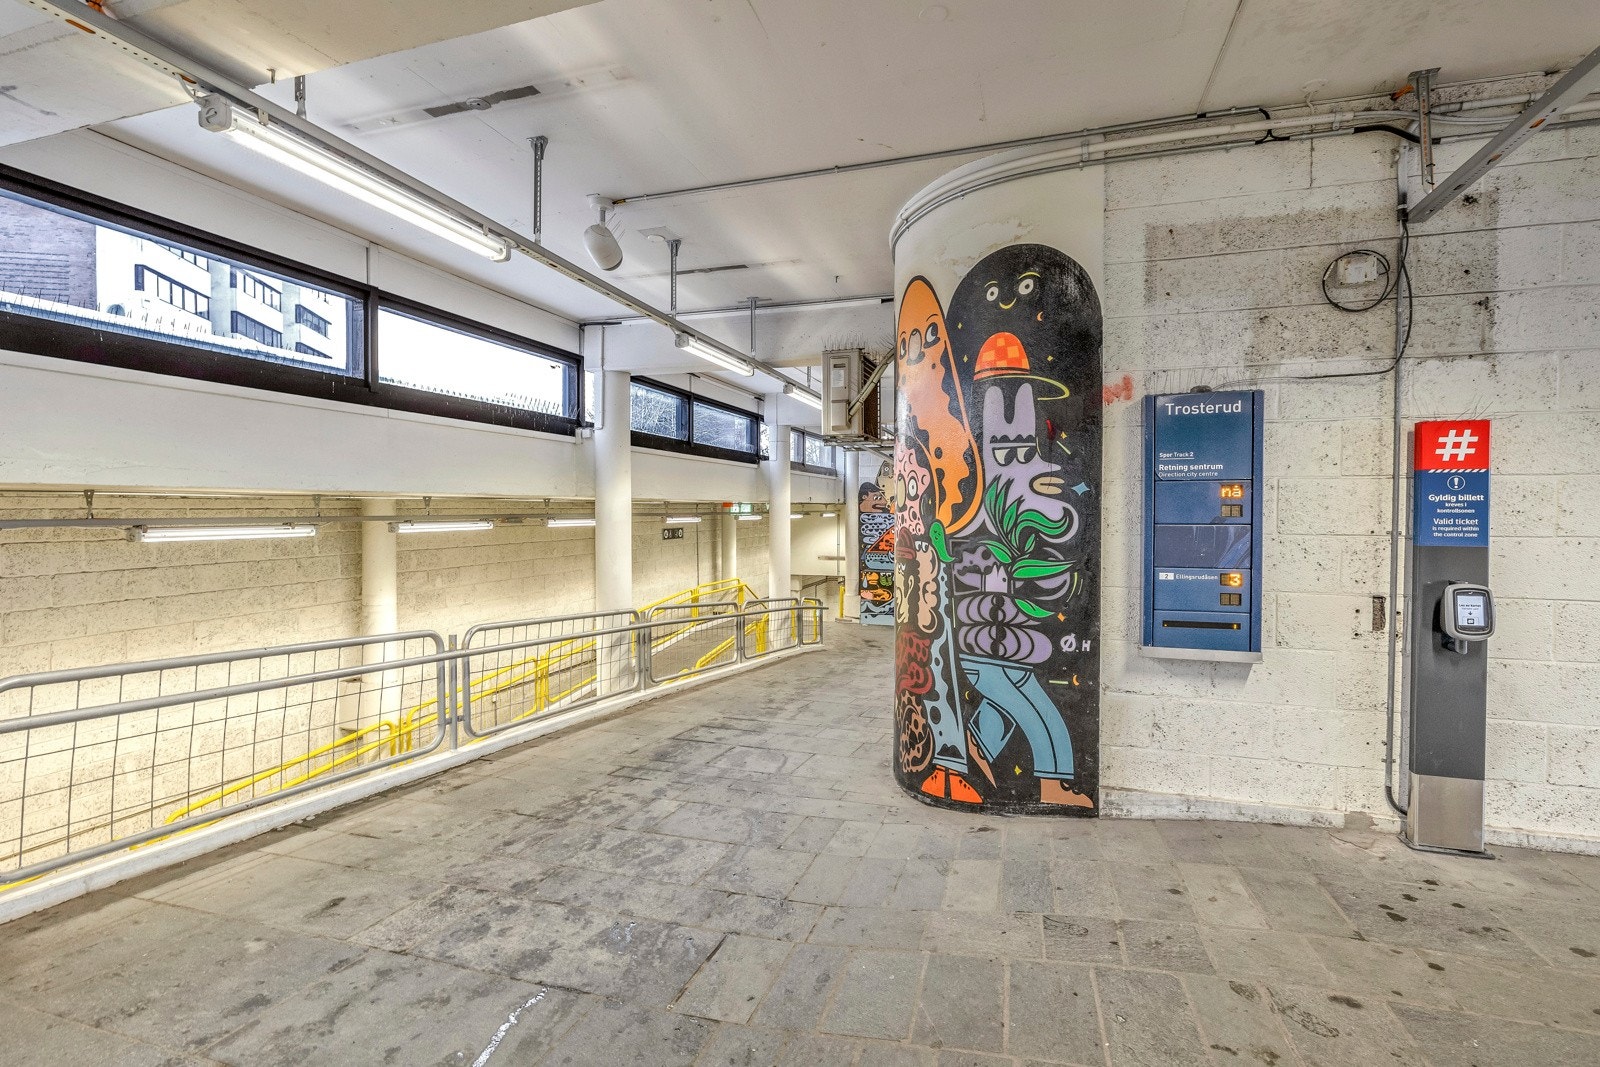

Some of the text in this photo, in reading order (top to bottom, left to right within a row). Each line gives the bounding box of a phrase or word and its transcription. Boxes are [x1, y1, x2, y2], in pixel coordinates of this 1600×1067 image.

[1165, 400, 1242, 416] Trosterud
[1222, 485, 1242, 498] nå
[1428, 494, 1457, 502] Gyldig
[1230, 574, 1240, 586] 3
